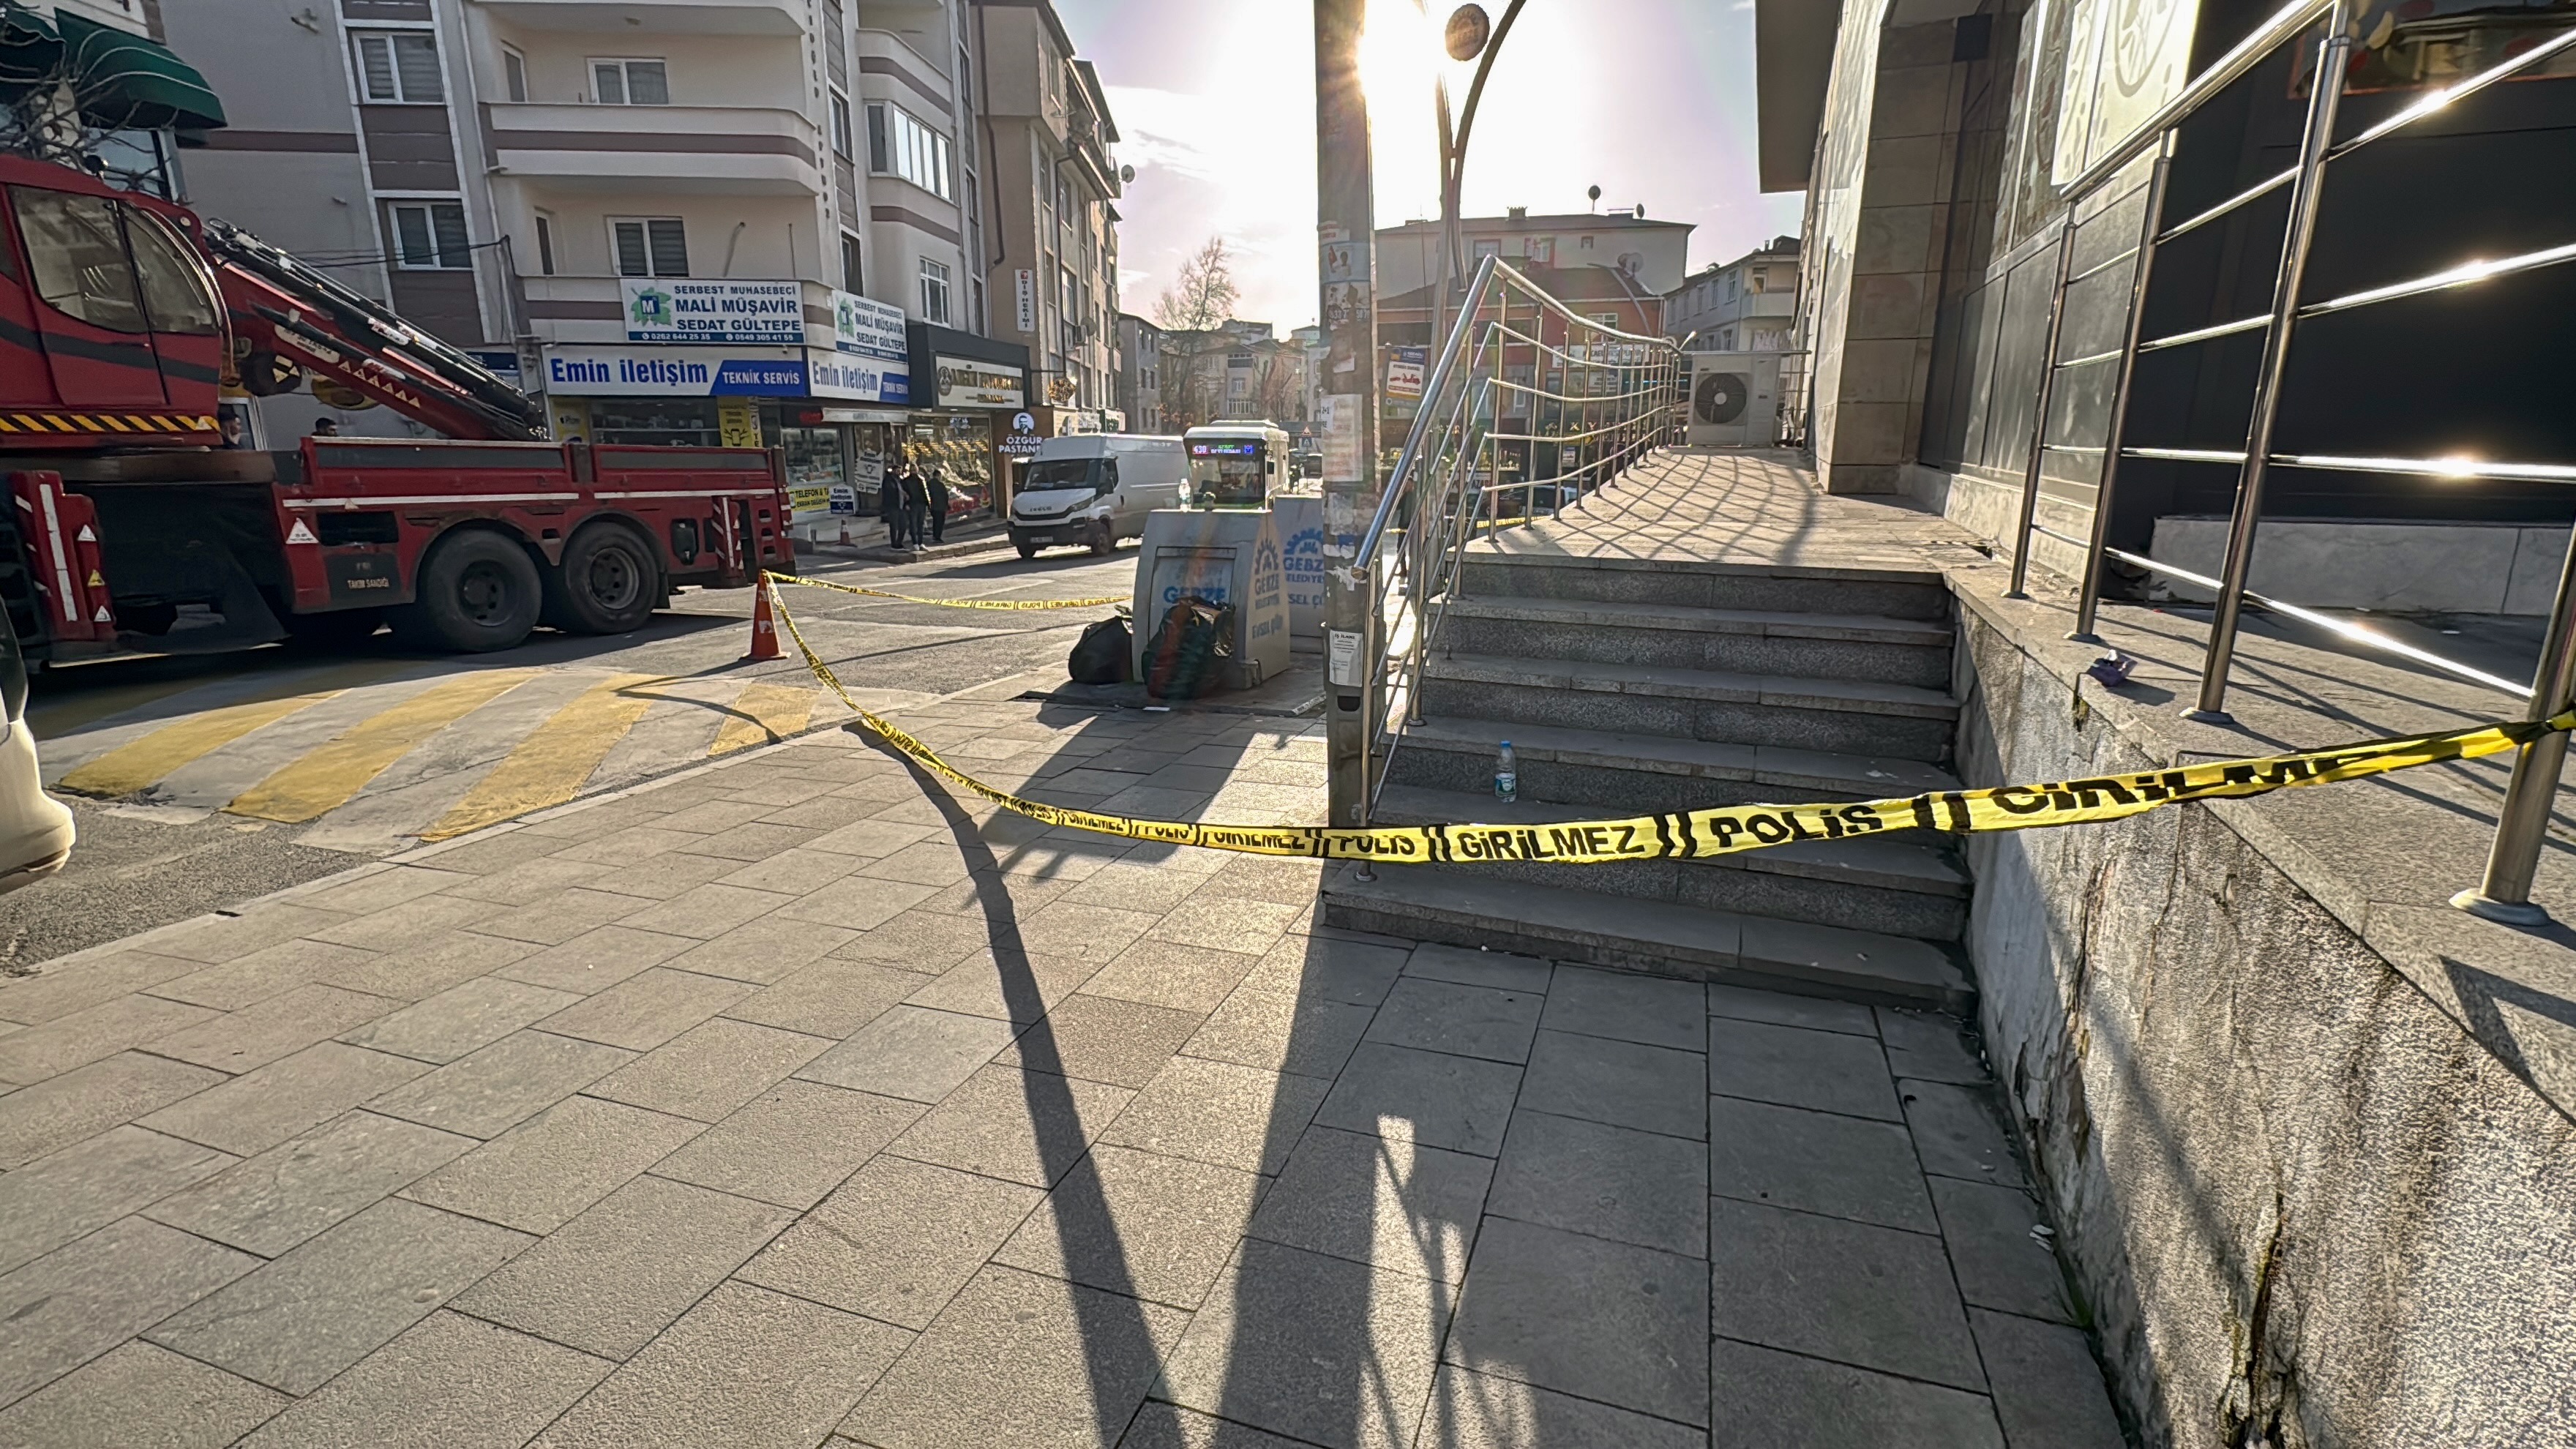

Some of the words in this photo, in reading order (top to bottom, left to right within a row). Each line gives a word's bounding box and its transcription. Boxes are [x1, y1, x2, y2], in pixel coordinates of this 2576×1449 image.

[674, 285, 724, 295] SERBEST
[675, 296, 716, 313] MALİ
[722, 296, 798, 316] MÜŞAVİR
[677, 319, 726, 331] SEDAT
[731, 317, 801, 332] GÜLTEPE
[855, 312, 874, 328] MALİ
[875, 317, 905, 336] MÜŞAVİR
[856, 332, 877, 346] SEDAT
[879, 334, 906, 351] GÜLTEPE
[550, 358, 611, 383] Emin
[619, 359, 708, 386] iletişim
[722, 369, 761, 385] TEKNİK
[763, 369, 800, 385] SERVİS
[812, 360, 840, 387] Emin
[842, 365, 878, 393] iletişim
[1006, 433, 1042, 445] ÖZGÜR
[795, 488, 819, 498] TELEFON
[1284, 556, 1324, 572] GEBZ
[1254, 574, 1279, 596] GEBZE
